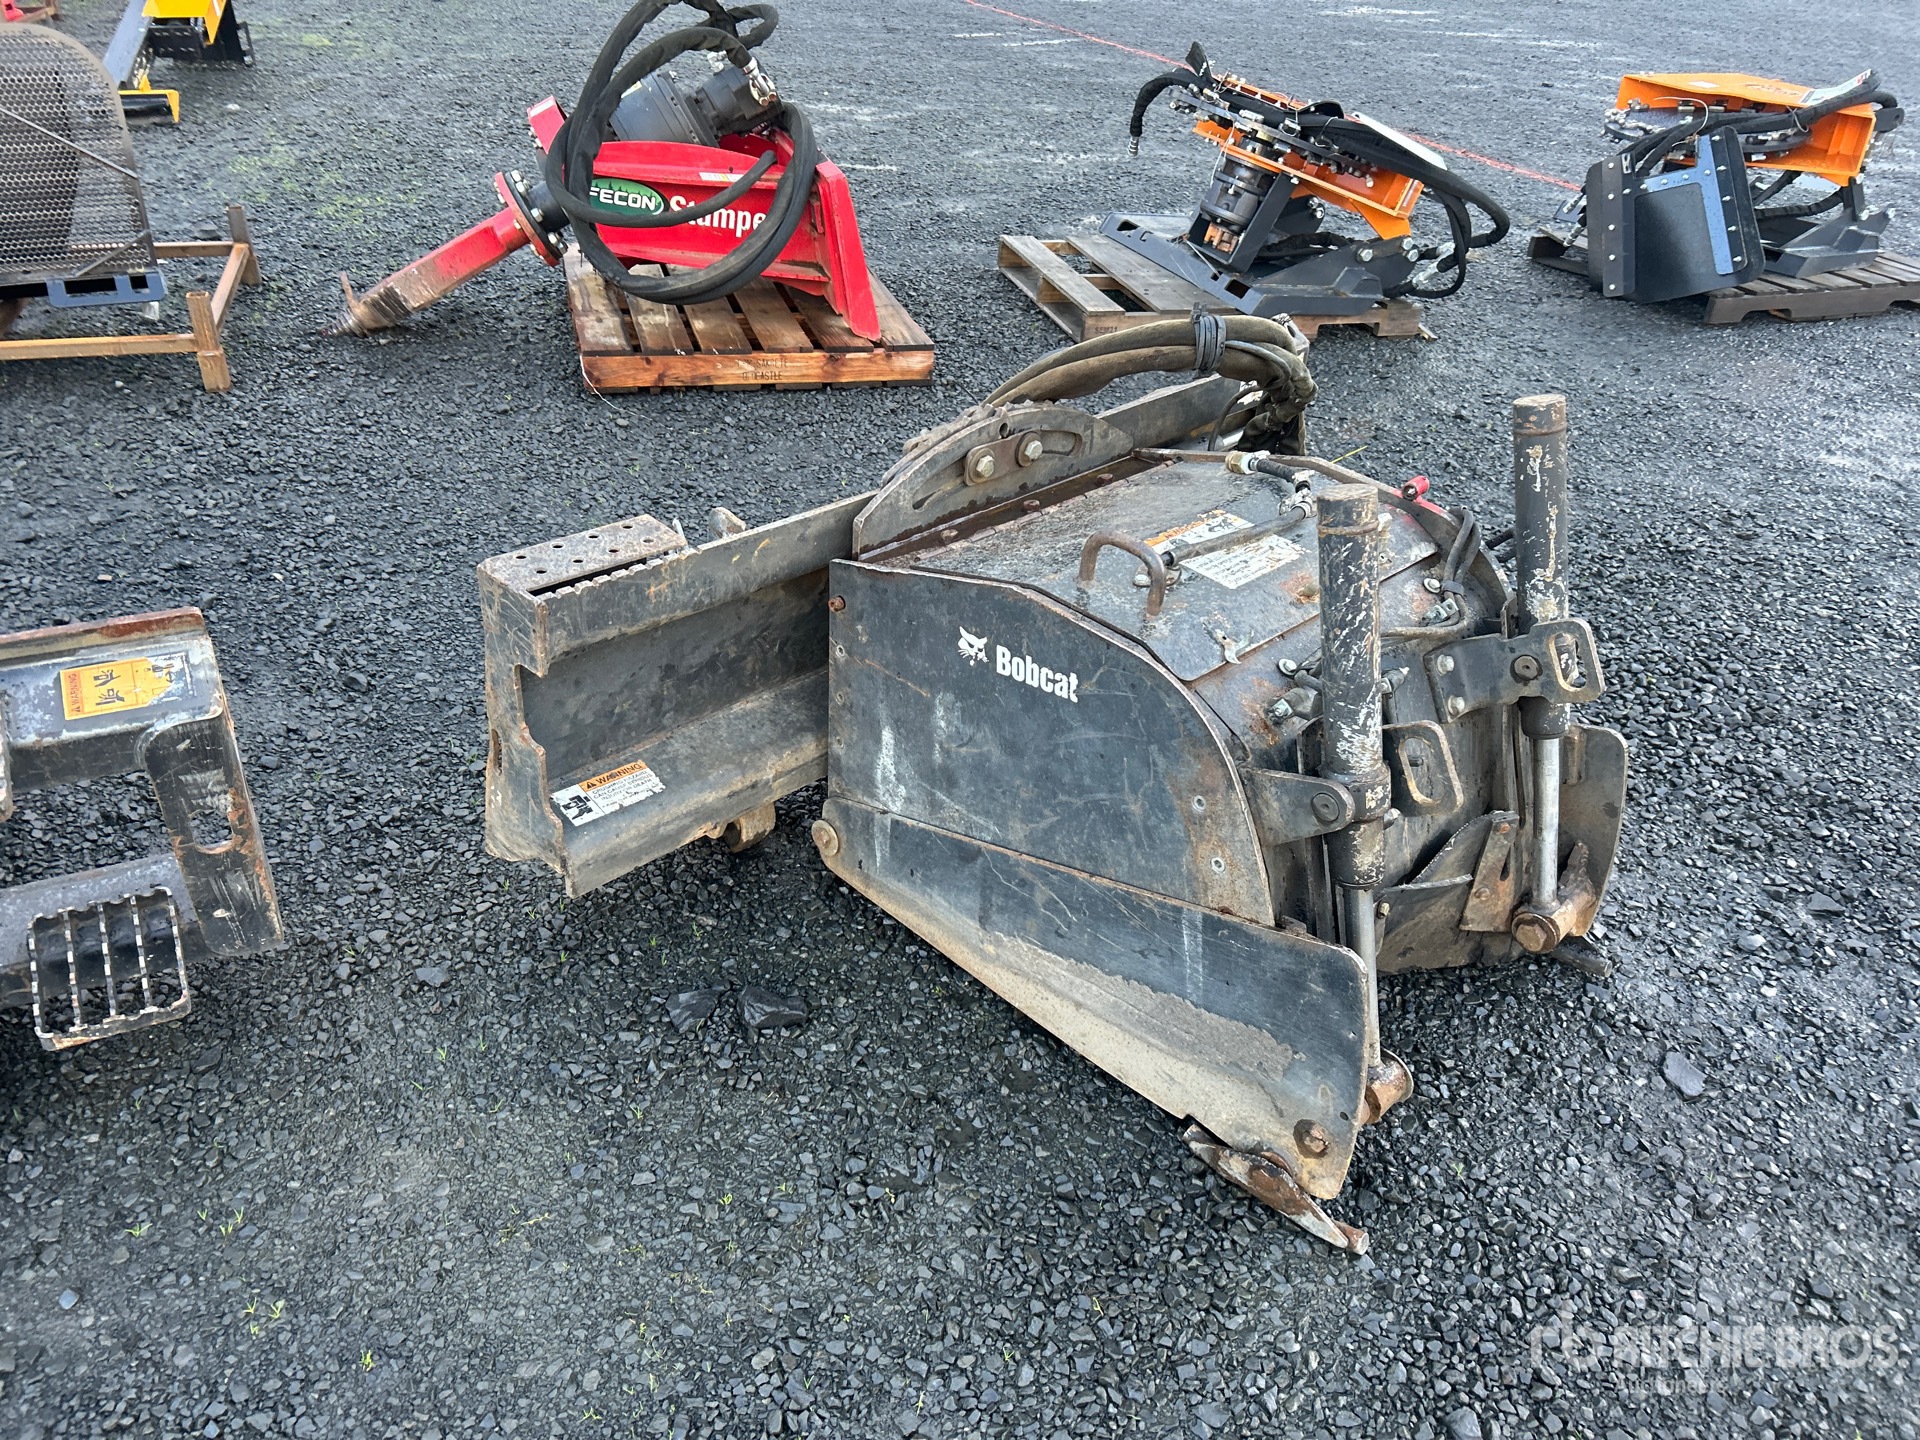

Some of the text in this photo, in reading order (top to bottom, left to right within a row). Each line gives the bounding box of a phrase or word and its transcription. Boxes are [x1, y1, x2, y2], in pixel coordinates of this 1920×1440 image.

[589, 186, 656, 211] FECON
[69, 673, 80, 706] WARNING
[996, 645, 1079, 704] Bobcat
